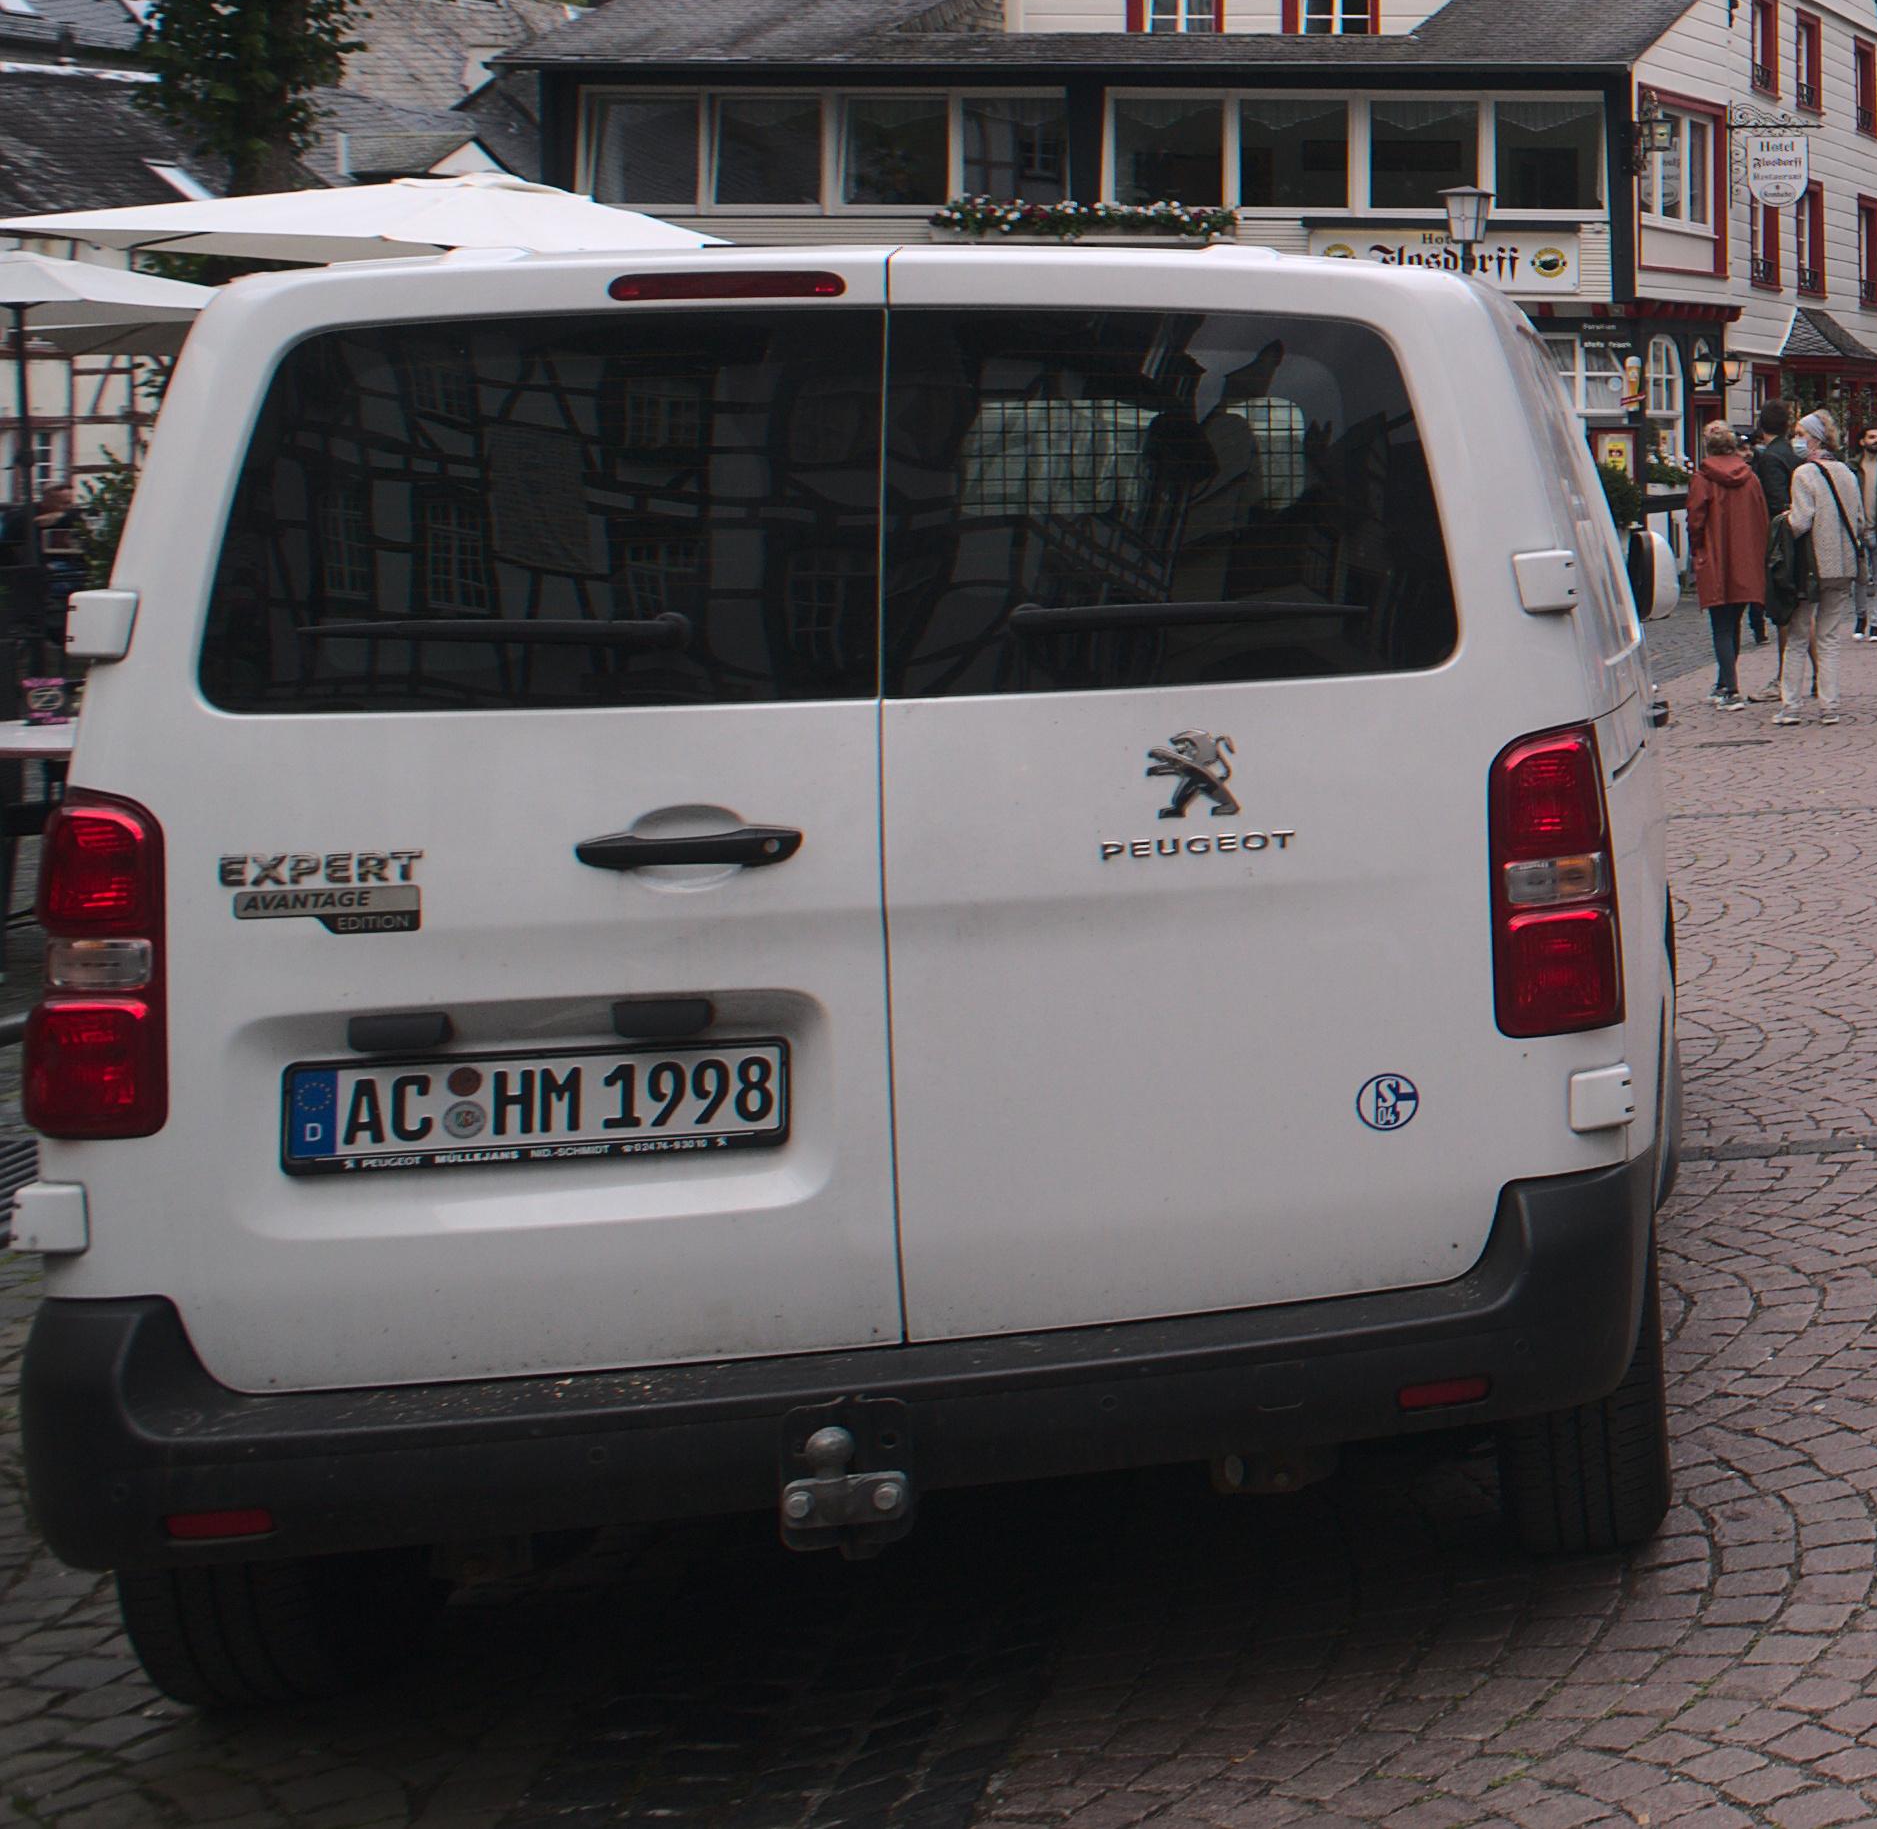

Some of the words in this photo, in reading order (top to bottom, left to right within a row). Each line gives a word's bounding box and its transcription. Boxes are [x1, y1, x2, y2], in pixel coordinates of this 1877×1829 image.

[1760, 141, 1795, 152] Hotel
[1421, 232, 1453, 245] Hot
[1368, 243, 1520, 283] Flosdrff
[1101, 829, 1295, 861] PEUGEOT
[219, 849, 424, 888] EXPERT
[242, 890, 371, 913] AVANTAGE
[337, 914, 411, 931] EDITION
[342, 1074, 434, 1146] AC
[493, 1065, 582, 1136] HM
[602, 1055, 774, 1130] 1998
[304, 1122, 322, 1142] D
[361, 1155, 423, 1169] PEUGEOT
